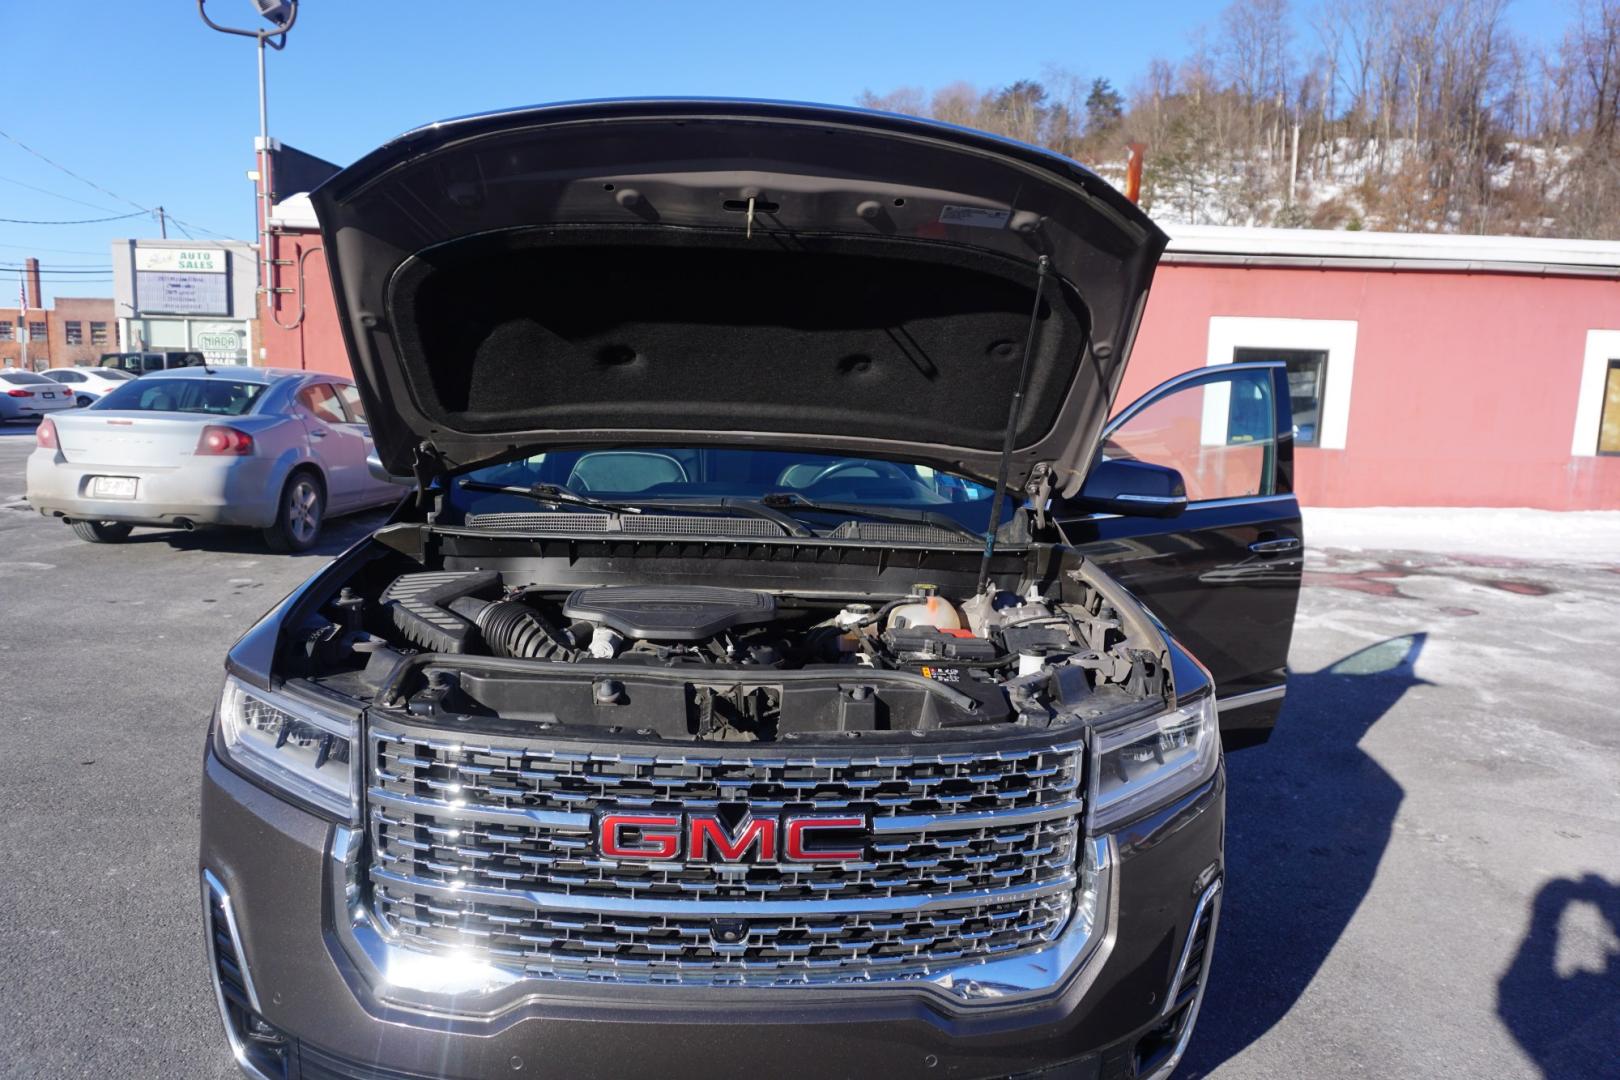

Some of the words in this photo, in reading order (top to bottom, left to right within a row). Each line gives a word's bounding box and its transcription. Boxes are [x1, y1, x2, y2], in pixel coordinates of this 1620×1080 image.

[180, 252, 211, 260] AUTO
[178, 260, 214, 269] SALES
[598, 812, 866, 863] GMC
